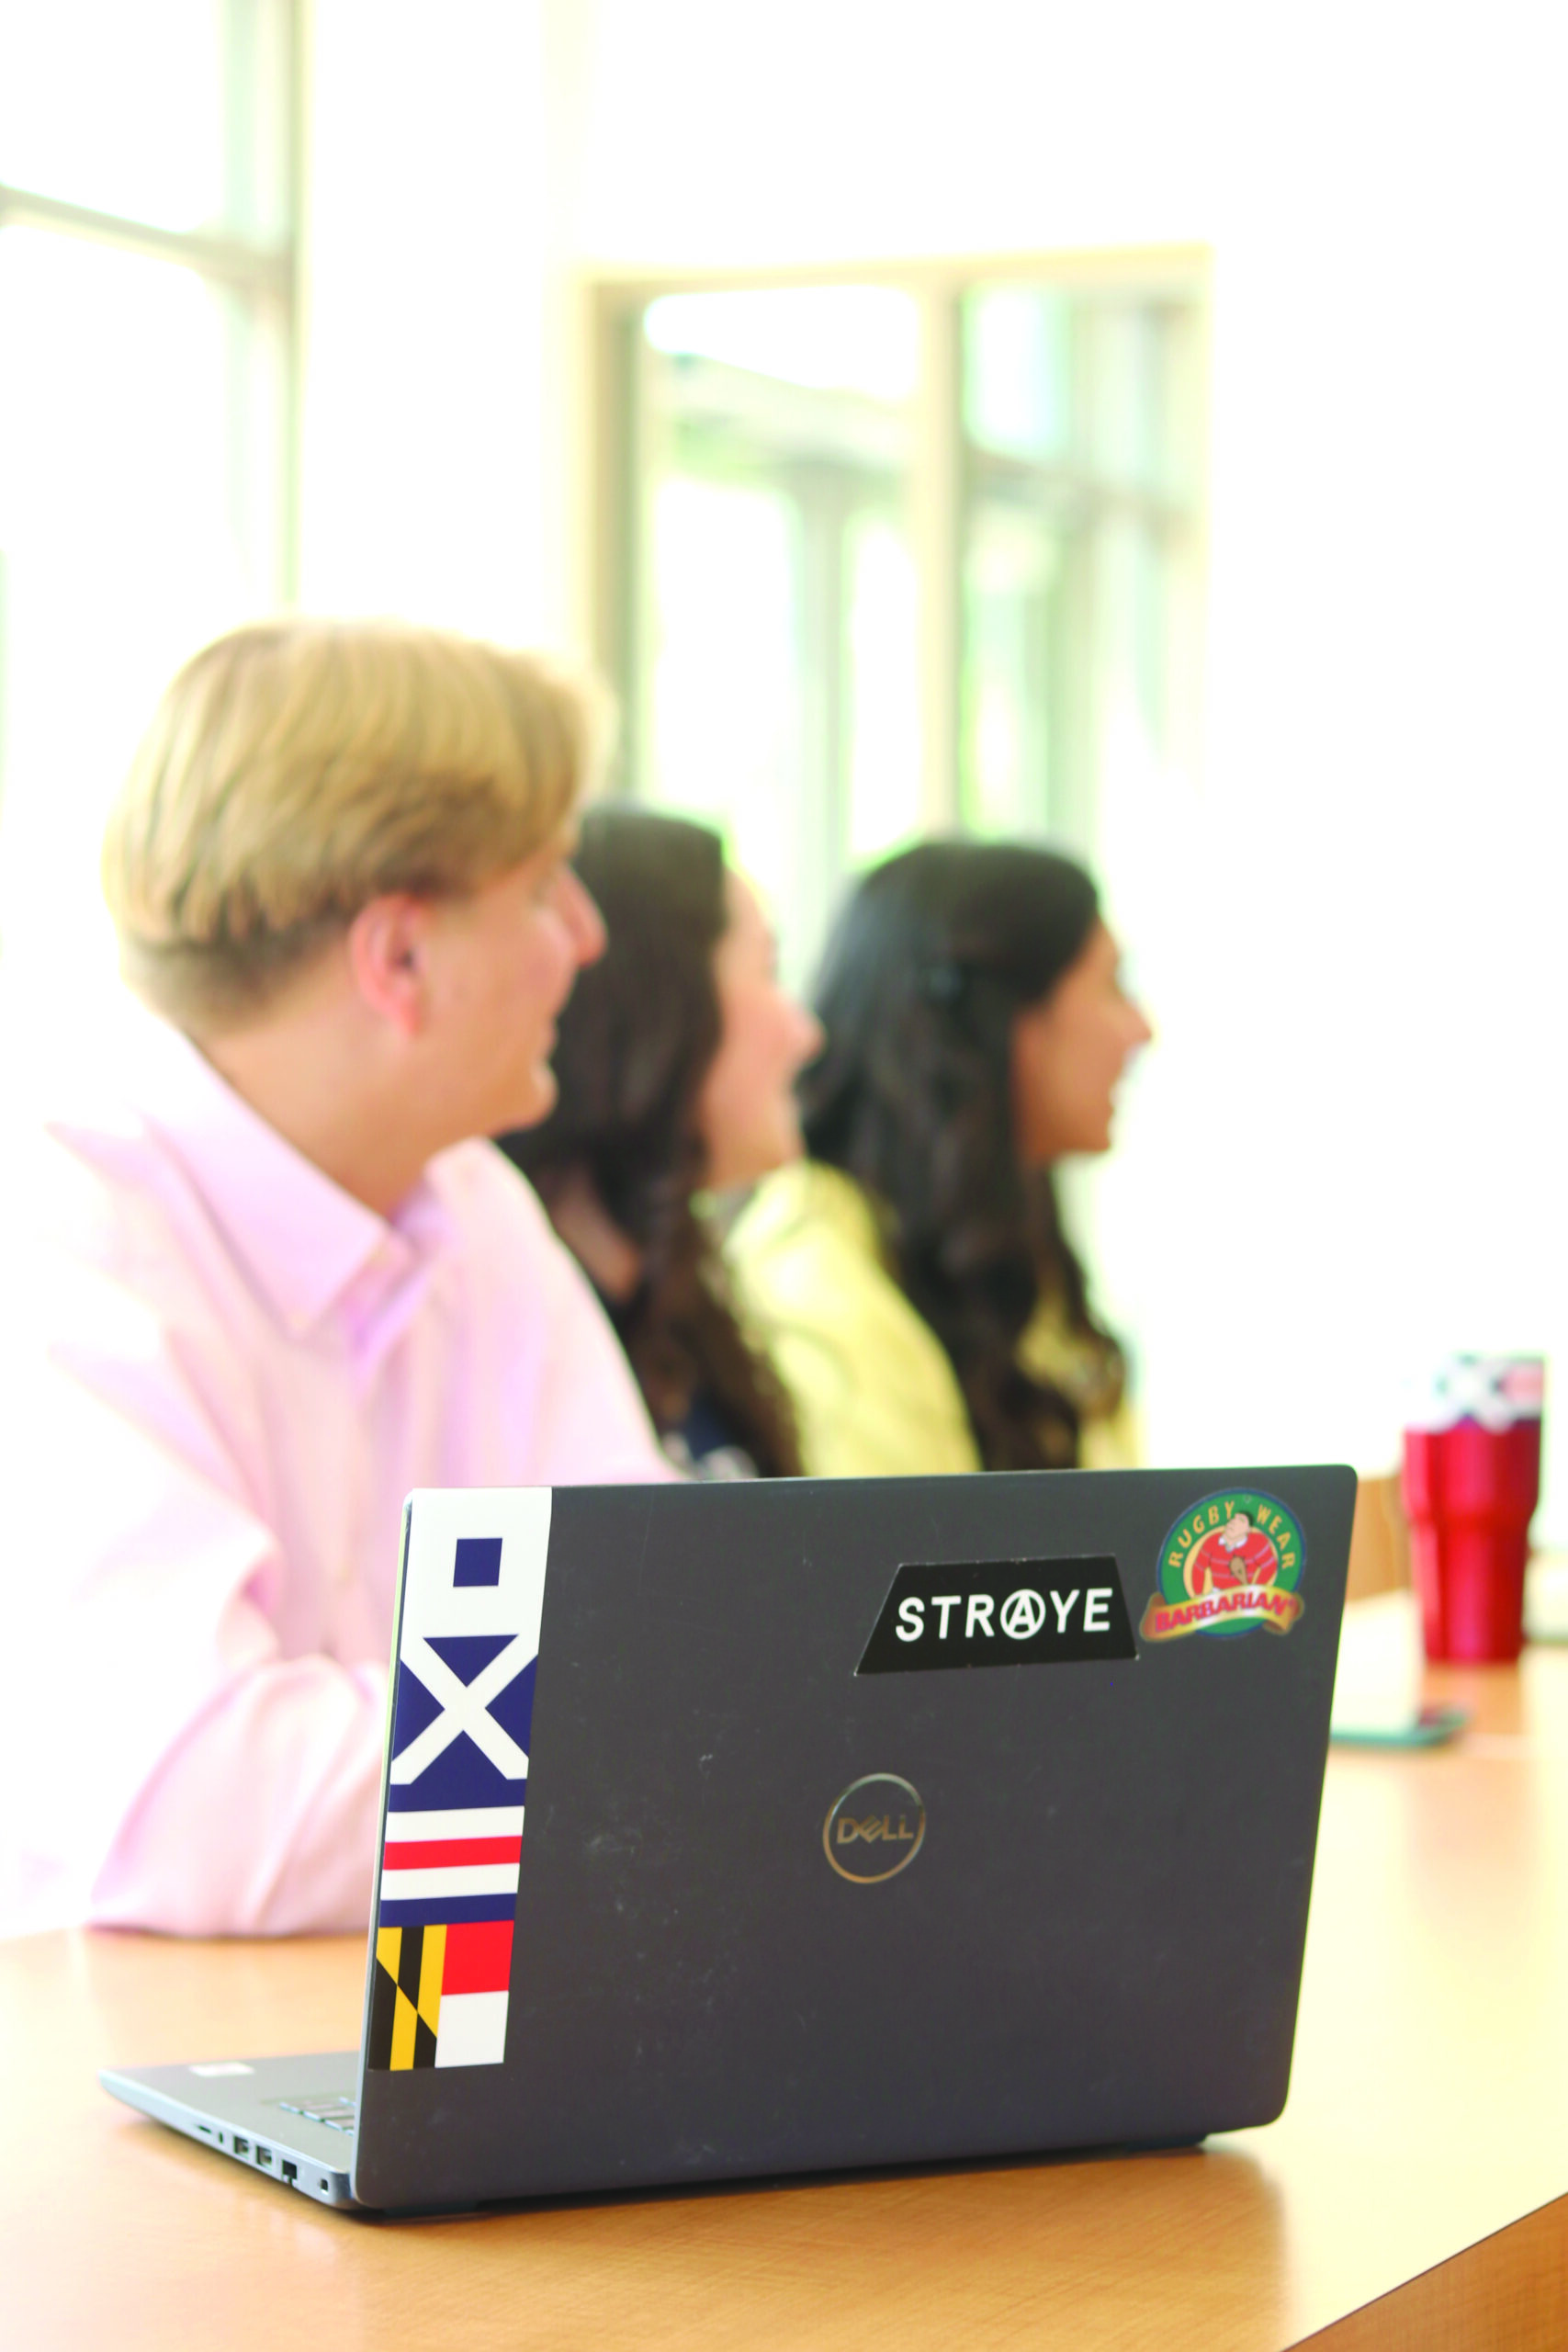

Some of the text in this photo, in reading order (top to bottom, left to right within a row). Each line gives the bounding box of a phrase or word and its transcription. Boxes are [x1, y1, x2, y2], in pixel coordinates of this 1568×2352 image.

[1168, 1501, 1295, 1569] RUGBY WEAR
[895, 1589, 1113, 1641] STRAYE
[837, 1815, 913, 1843] DELL
